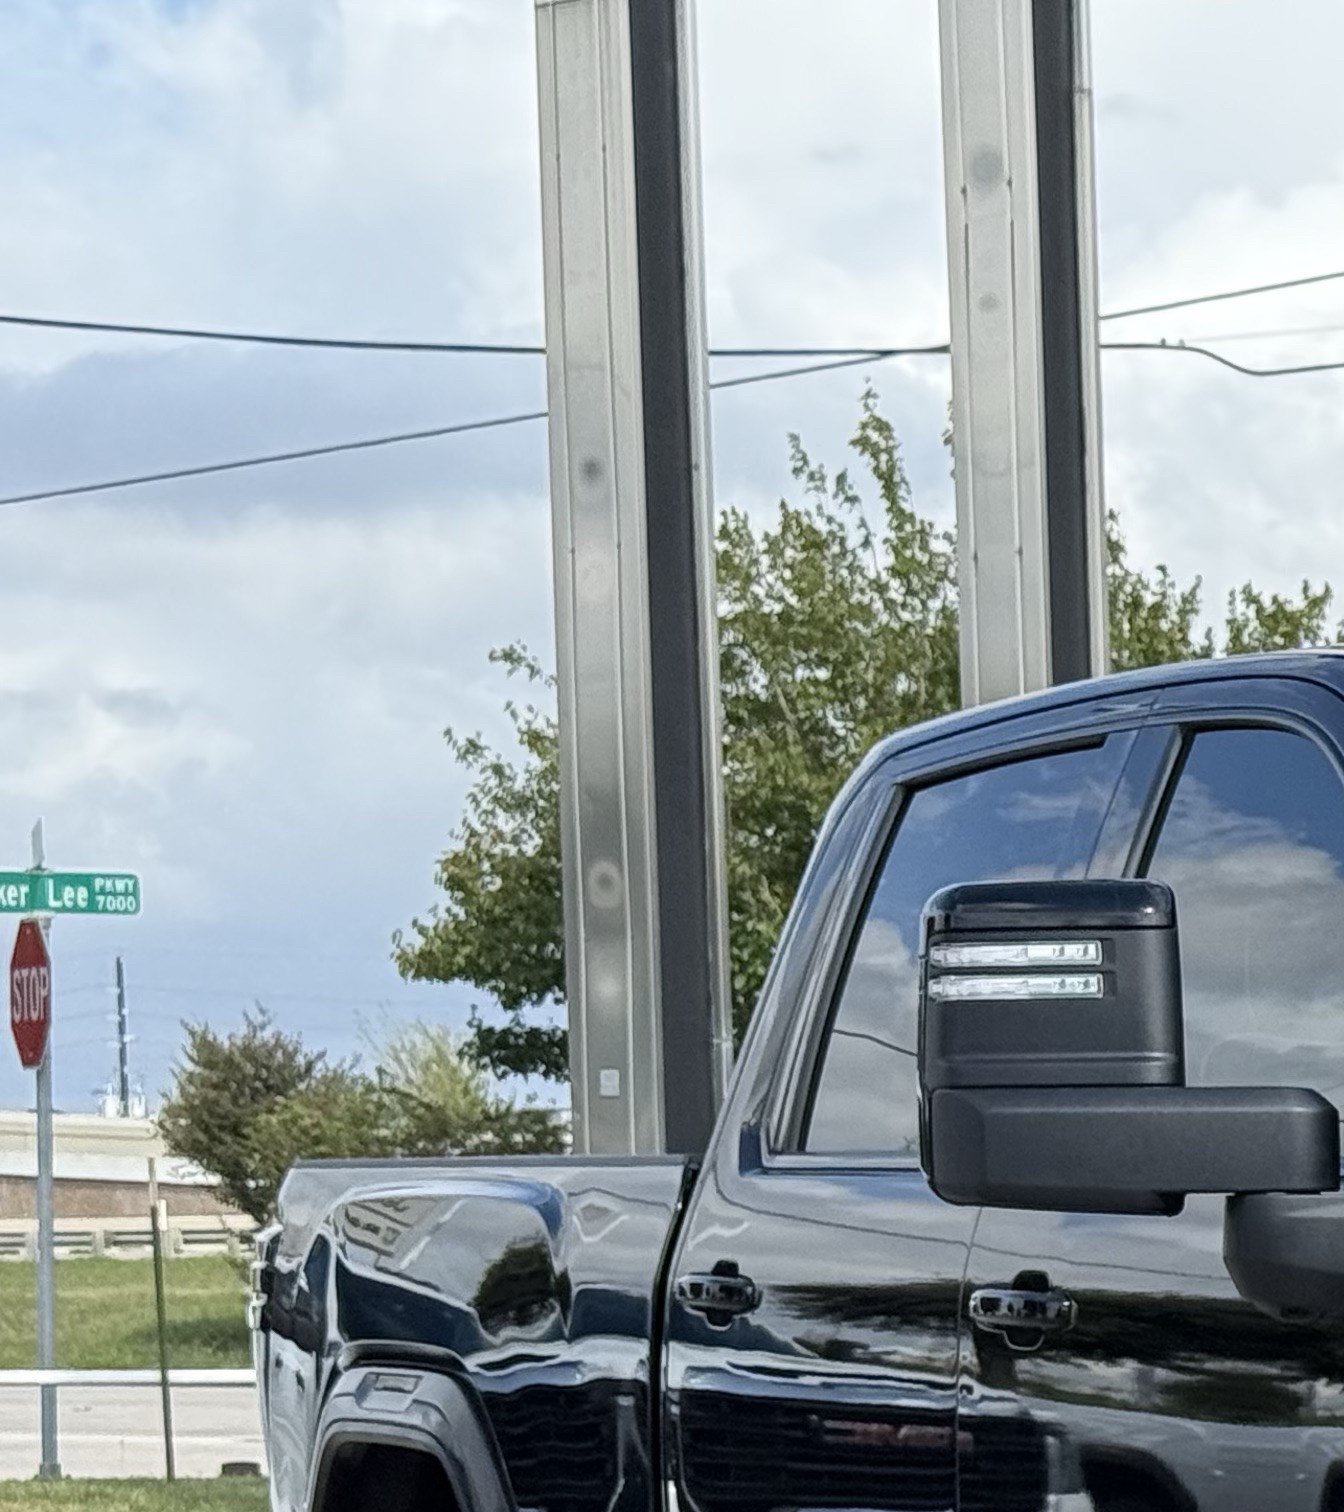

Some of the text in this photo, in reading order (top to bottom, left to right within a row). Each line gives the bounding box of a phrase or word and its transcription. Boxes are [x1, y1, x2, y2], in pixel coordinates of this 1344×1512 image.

[48, 878, 89, 908] Lee
[94, 877, 136, 893] PKWY
[95, 895, 136, 911] 7000
[13, 967, 49, 1023] STOP
